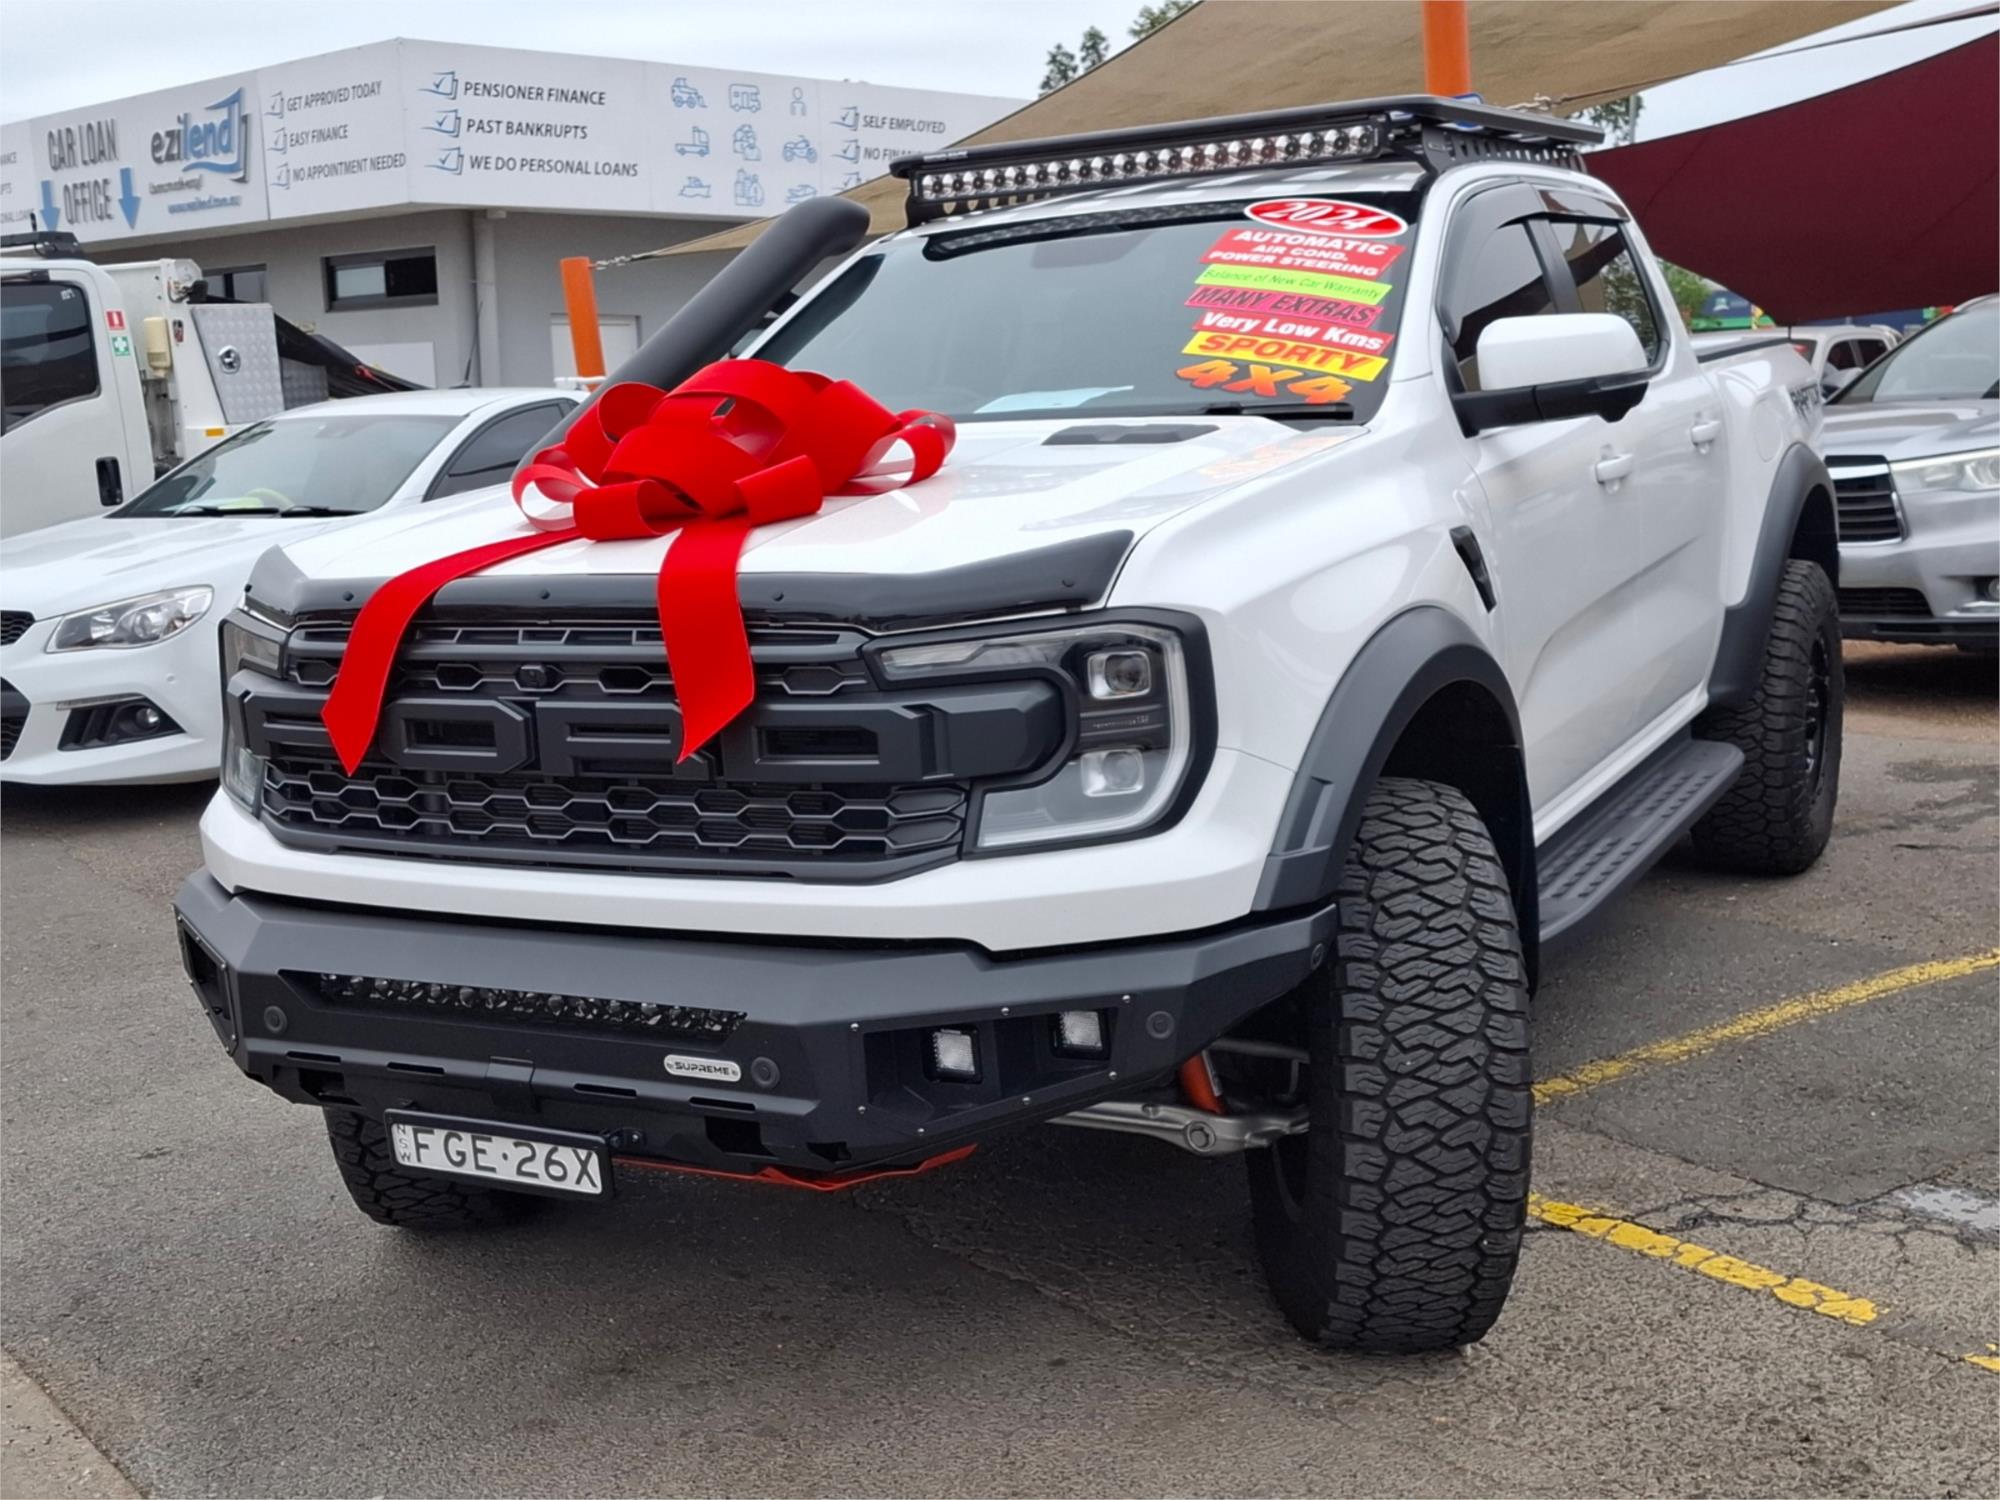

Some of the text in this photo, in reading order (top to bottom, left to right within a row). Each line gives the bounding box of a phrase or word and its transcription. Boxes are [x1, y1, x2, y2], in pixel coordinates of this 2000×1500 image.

[286, 80, 382, 112] GET APPROVED TODAY
[463, 81, 606, 105] PENSIONER FINANCE
[151, 110, 237, 165] ezilend
[289, 124, 349, 147] EASY FINANCE
[466, 118, 588, 140] PAST BANKRUPTS
[863, 114, 946, 134] SELF EMPLOYED
[47, 118, 119, 172] CAR LOAN
[863, 147, 880, 160] NO
[292, 152, 406, 182] NO APPOINTMENT NEEDED
[469, 155, 639, 177] WE DO PERSONAL LOANS
[63, 178, 114, 225] OFFICE
[1260, 202, 1389, 231] 2024
[1233, 230, 1388, 256] AUTOMATIC
[1253, 244, 1349, 261] AIR COND.
[1208, 251, 1379, 277] POWER STEERING
[1203, 268, 1380, 299] Balance of New Car Warranty
[1195, 287, 1376, 322] MANY EXTRAS
[1202, 312, 1386, 351] Very Low Kms
[1198, 334, 1374, 372] SPORTY
[1175, 359, 1353, 405] 4X4
[674, 1061, 730, 1076] SUPREME
